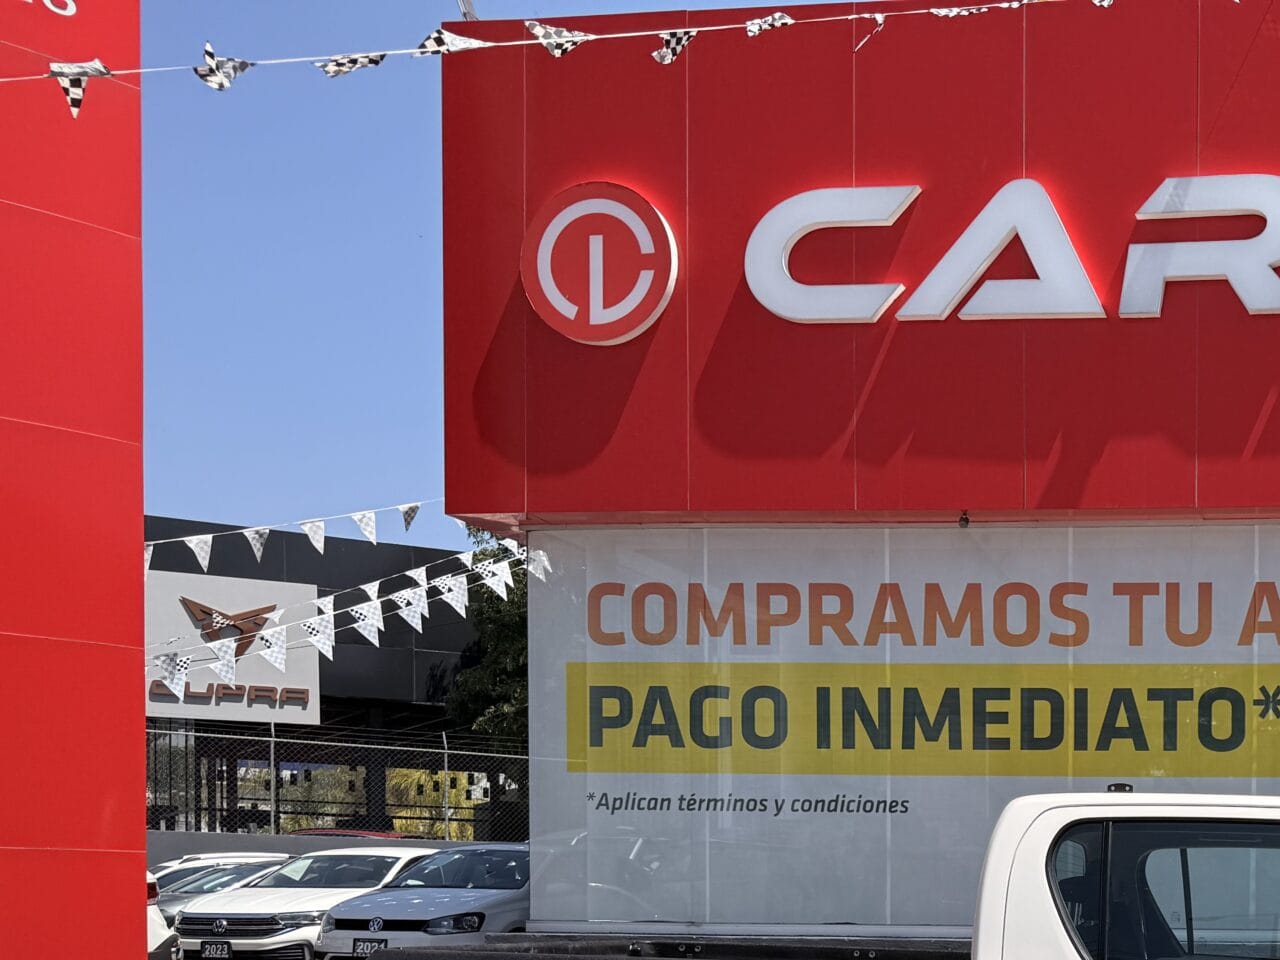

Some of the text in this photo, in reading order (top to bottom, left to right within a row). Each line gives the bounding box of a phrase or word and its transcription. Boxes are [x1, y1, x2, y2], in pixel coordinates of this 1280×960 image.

[587, 582, 1090, 648] COMPRAMOS
[1112, 582, 1213, 647] TU
[588, 685, 789, 750] PAGO
[678, 793, 768, 812] términos
[773, 798, 785, 816] y
[790, 795, 910, 814] condiciones
[205, 944, 228, 955] 2023
